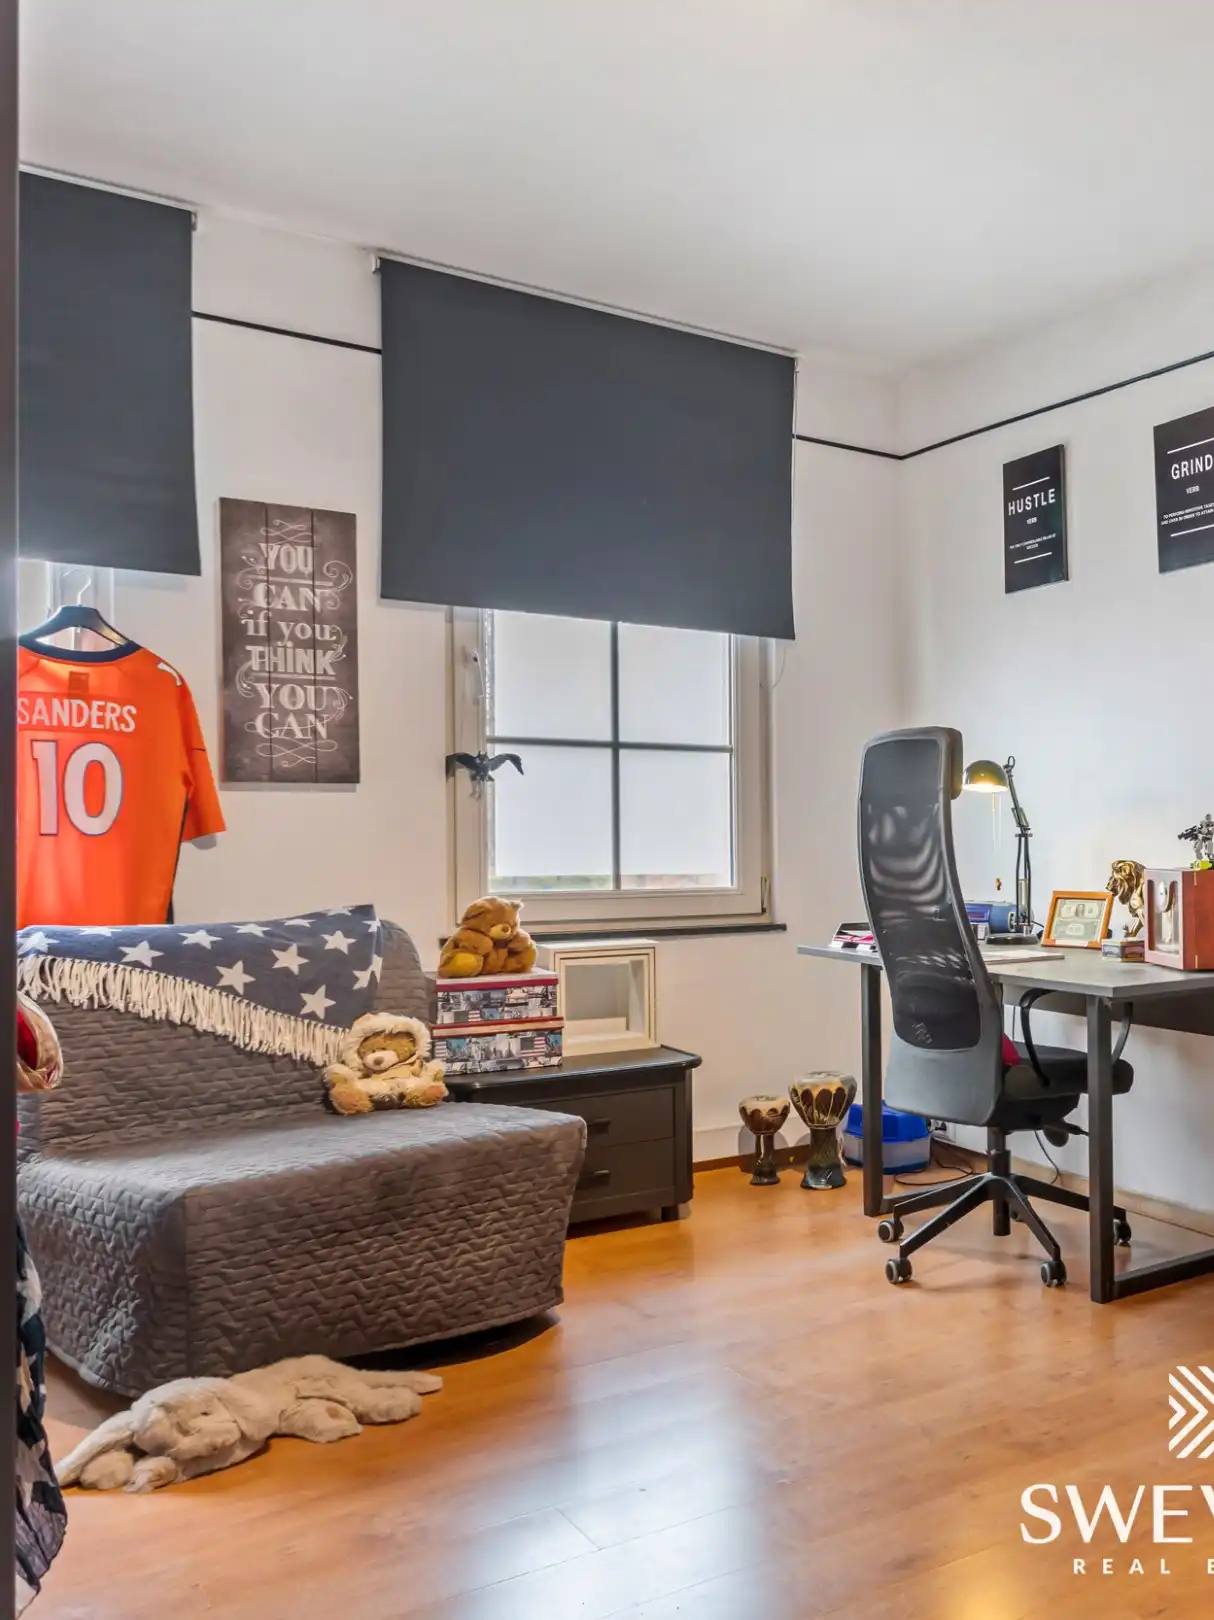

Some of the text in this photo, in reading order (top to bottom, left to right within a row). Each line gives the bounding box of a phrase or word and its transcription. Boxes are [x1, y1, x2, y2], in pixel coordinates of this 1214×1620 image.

[1171, 454, 1214, 480] GRIND
[1008, 488, 1056, 516] HUSTLE
[1186, 485, 1200, 495] VERB
[258, 543, 317, 575] YOU
[253, 582, 322, 613] CAN
[241, 610, 337, 647] if you
[252, 682, 335, 711] YOU
[17, 697, 137, 733] SANDERS
[254, 711, 329, 740] CAN
[30, 739, 124, 837] 10
